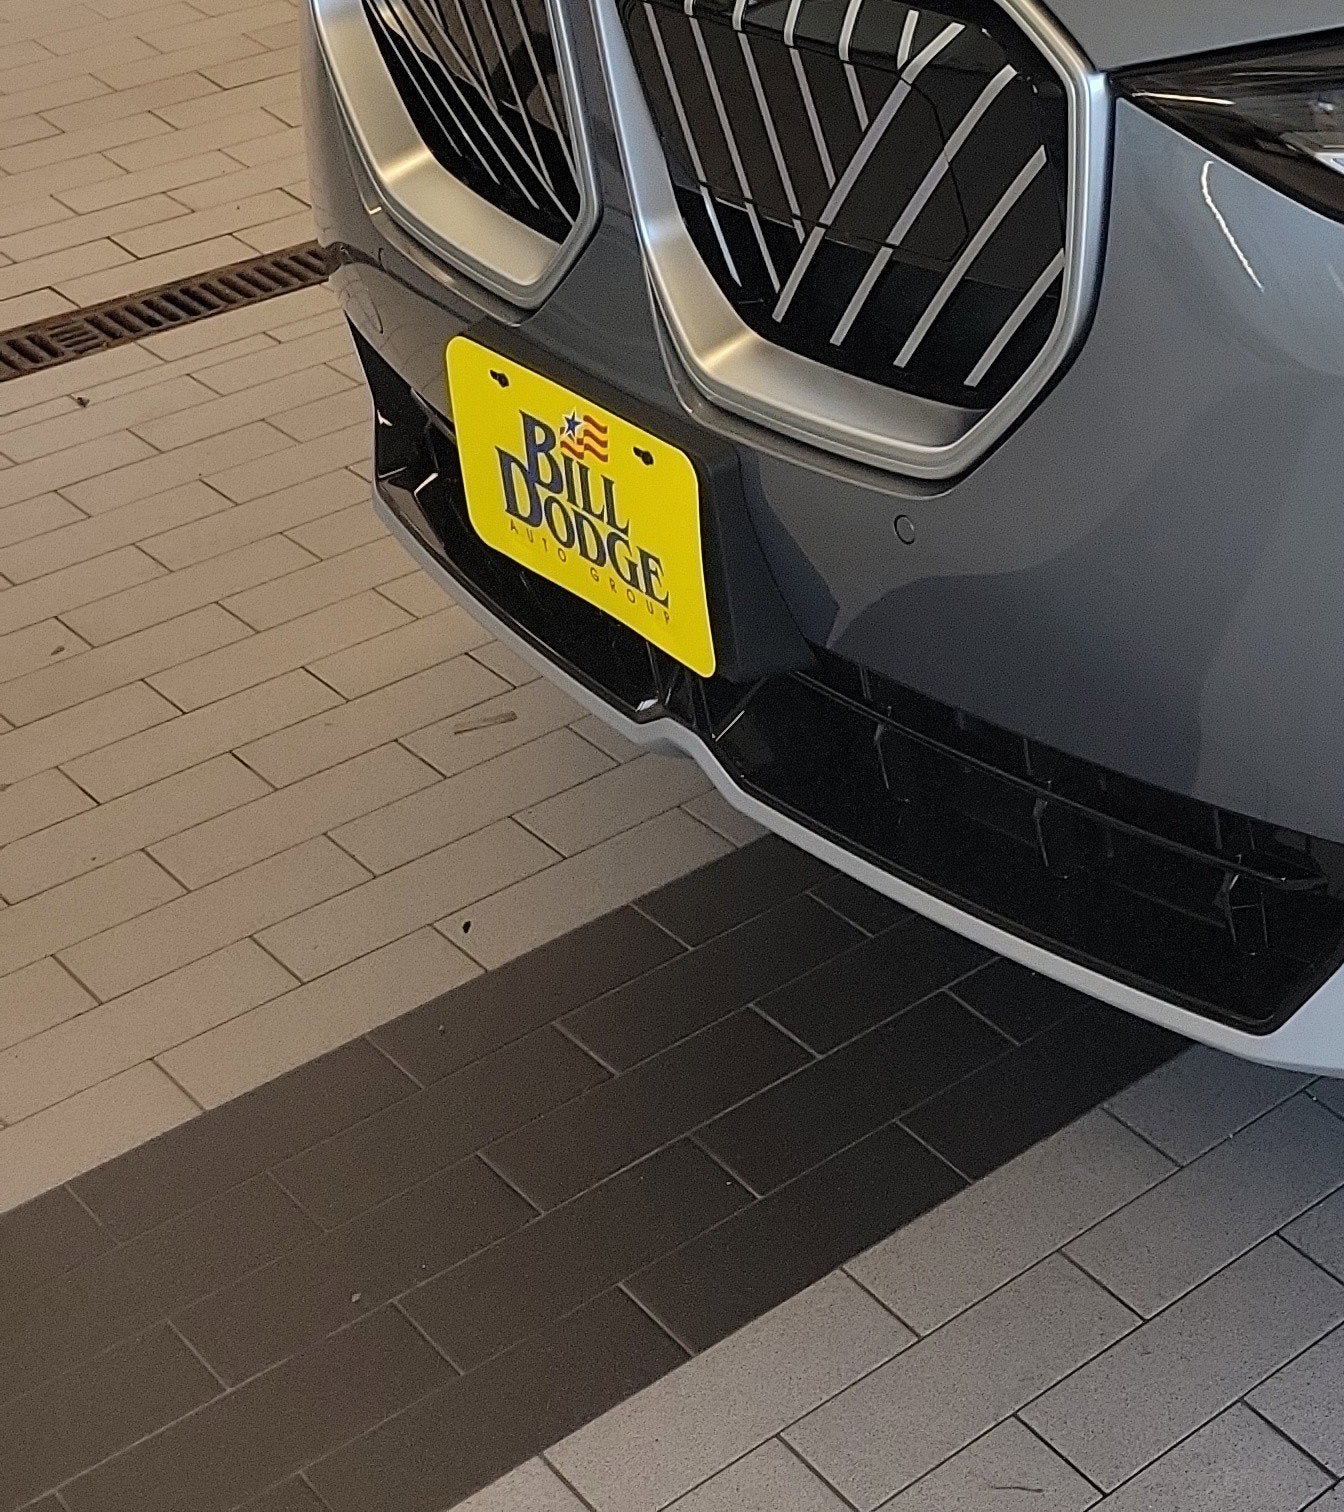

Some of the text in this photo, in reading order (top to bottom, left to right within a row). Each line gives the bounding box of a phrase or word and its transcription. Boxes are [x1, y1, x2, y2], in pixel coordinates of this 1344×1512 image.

[494, 444, 671, 610] DODGE
[518, 408, 631, 538] BILL
[510, 518, 671, 625] AUTO GROUP
